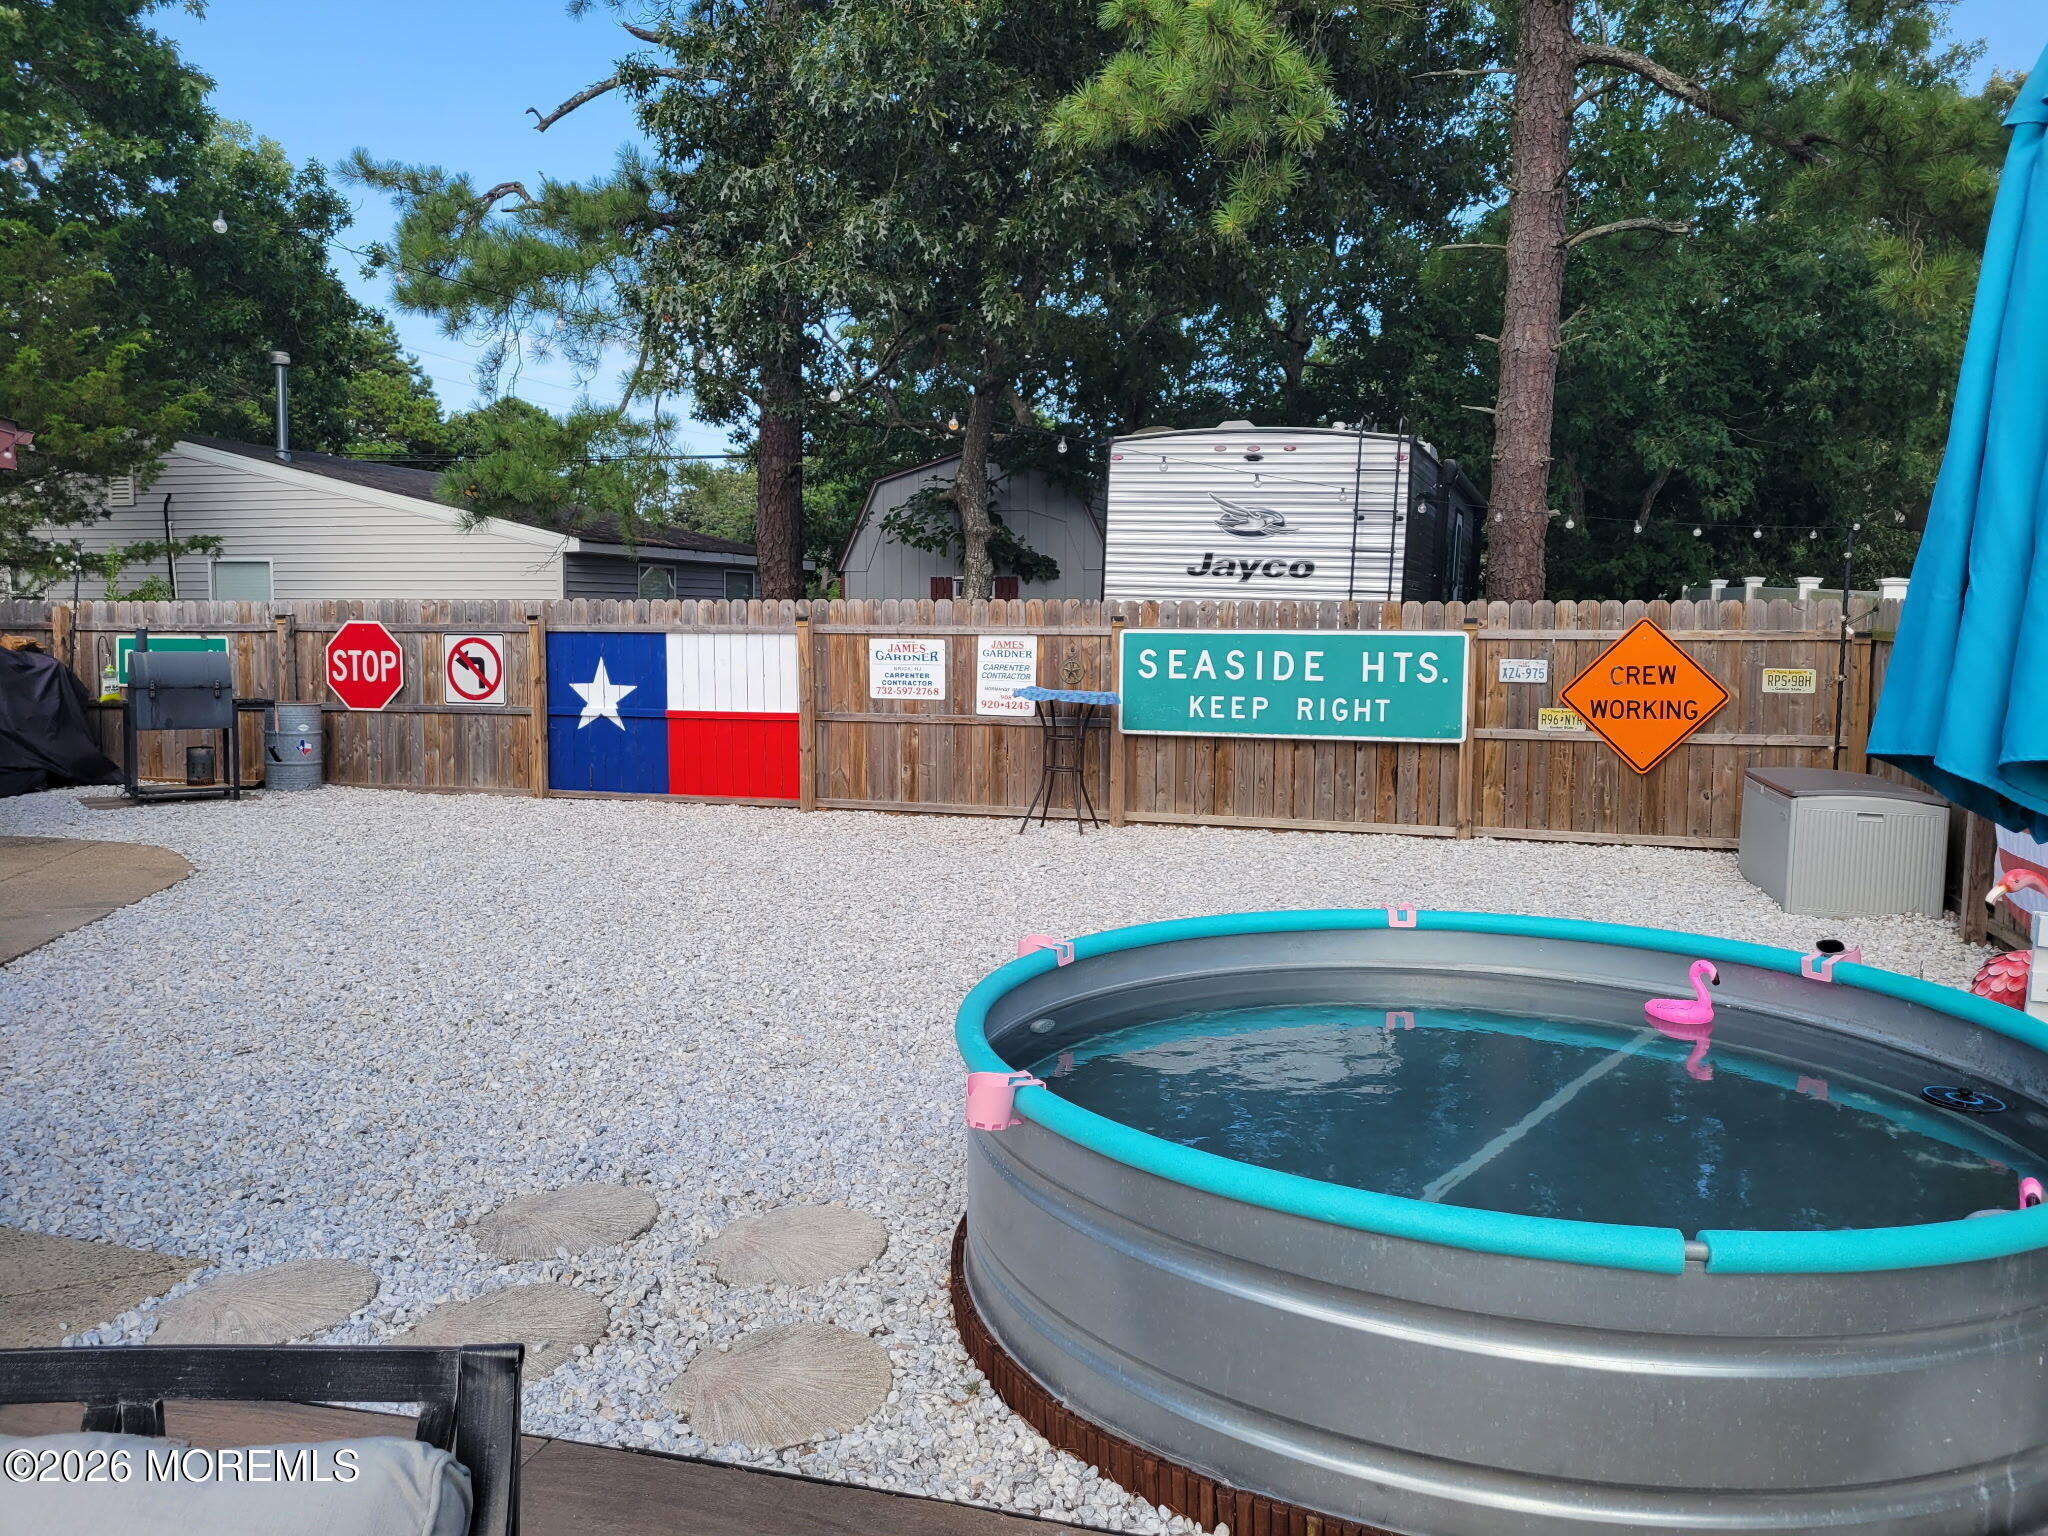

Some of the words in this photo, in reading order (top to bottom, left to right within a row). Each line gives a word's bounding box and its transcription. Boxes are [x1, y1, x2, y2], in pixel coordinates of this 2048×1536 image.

[1186, 552, 1315, 583] Jayco
[887, 643, 926, 653] JAMES
[991, 640, 1025, 649] JAMES
[875, 650, 938, 661] GARDNER
[982, 649, 1032, 659] GARDNER
[332, 649, 397, 683] STOP
[983, 663, 1031, 672] CARPENTER
[1137, 649, 1324, 682] SEASIDE
[1361, 650, 1449, 684] HTS.
[981, 672, 1031, 680] CONTRACTOR
[1610, 664, 1677, 686] CREW
[875, 686, 939, 696] 732-597-2768
[1188, 695, 1269, 720] KEEP
[1296, 697, 1391, 722] RIGHT
[1590, 699, 1699, 721] WORKING
